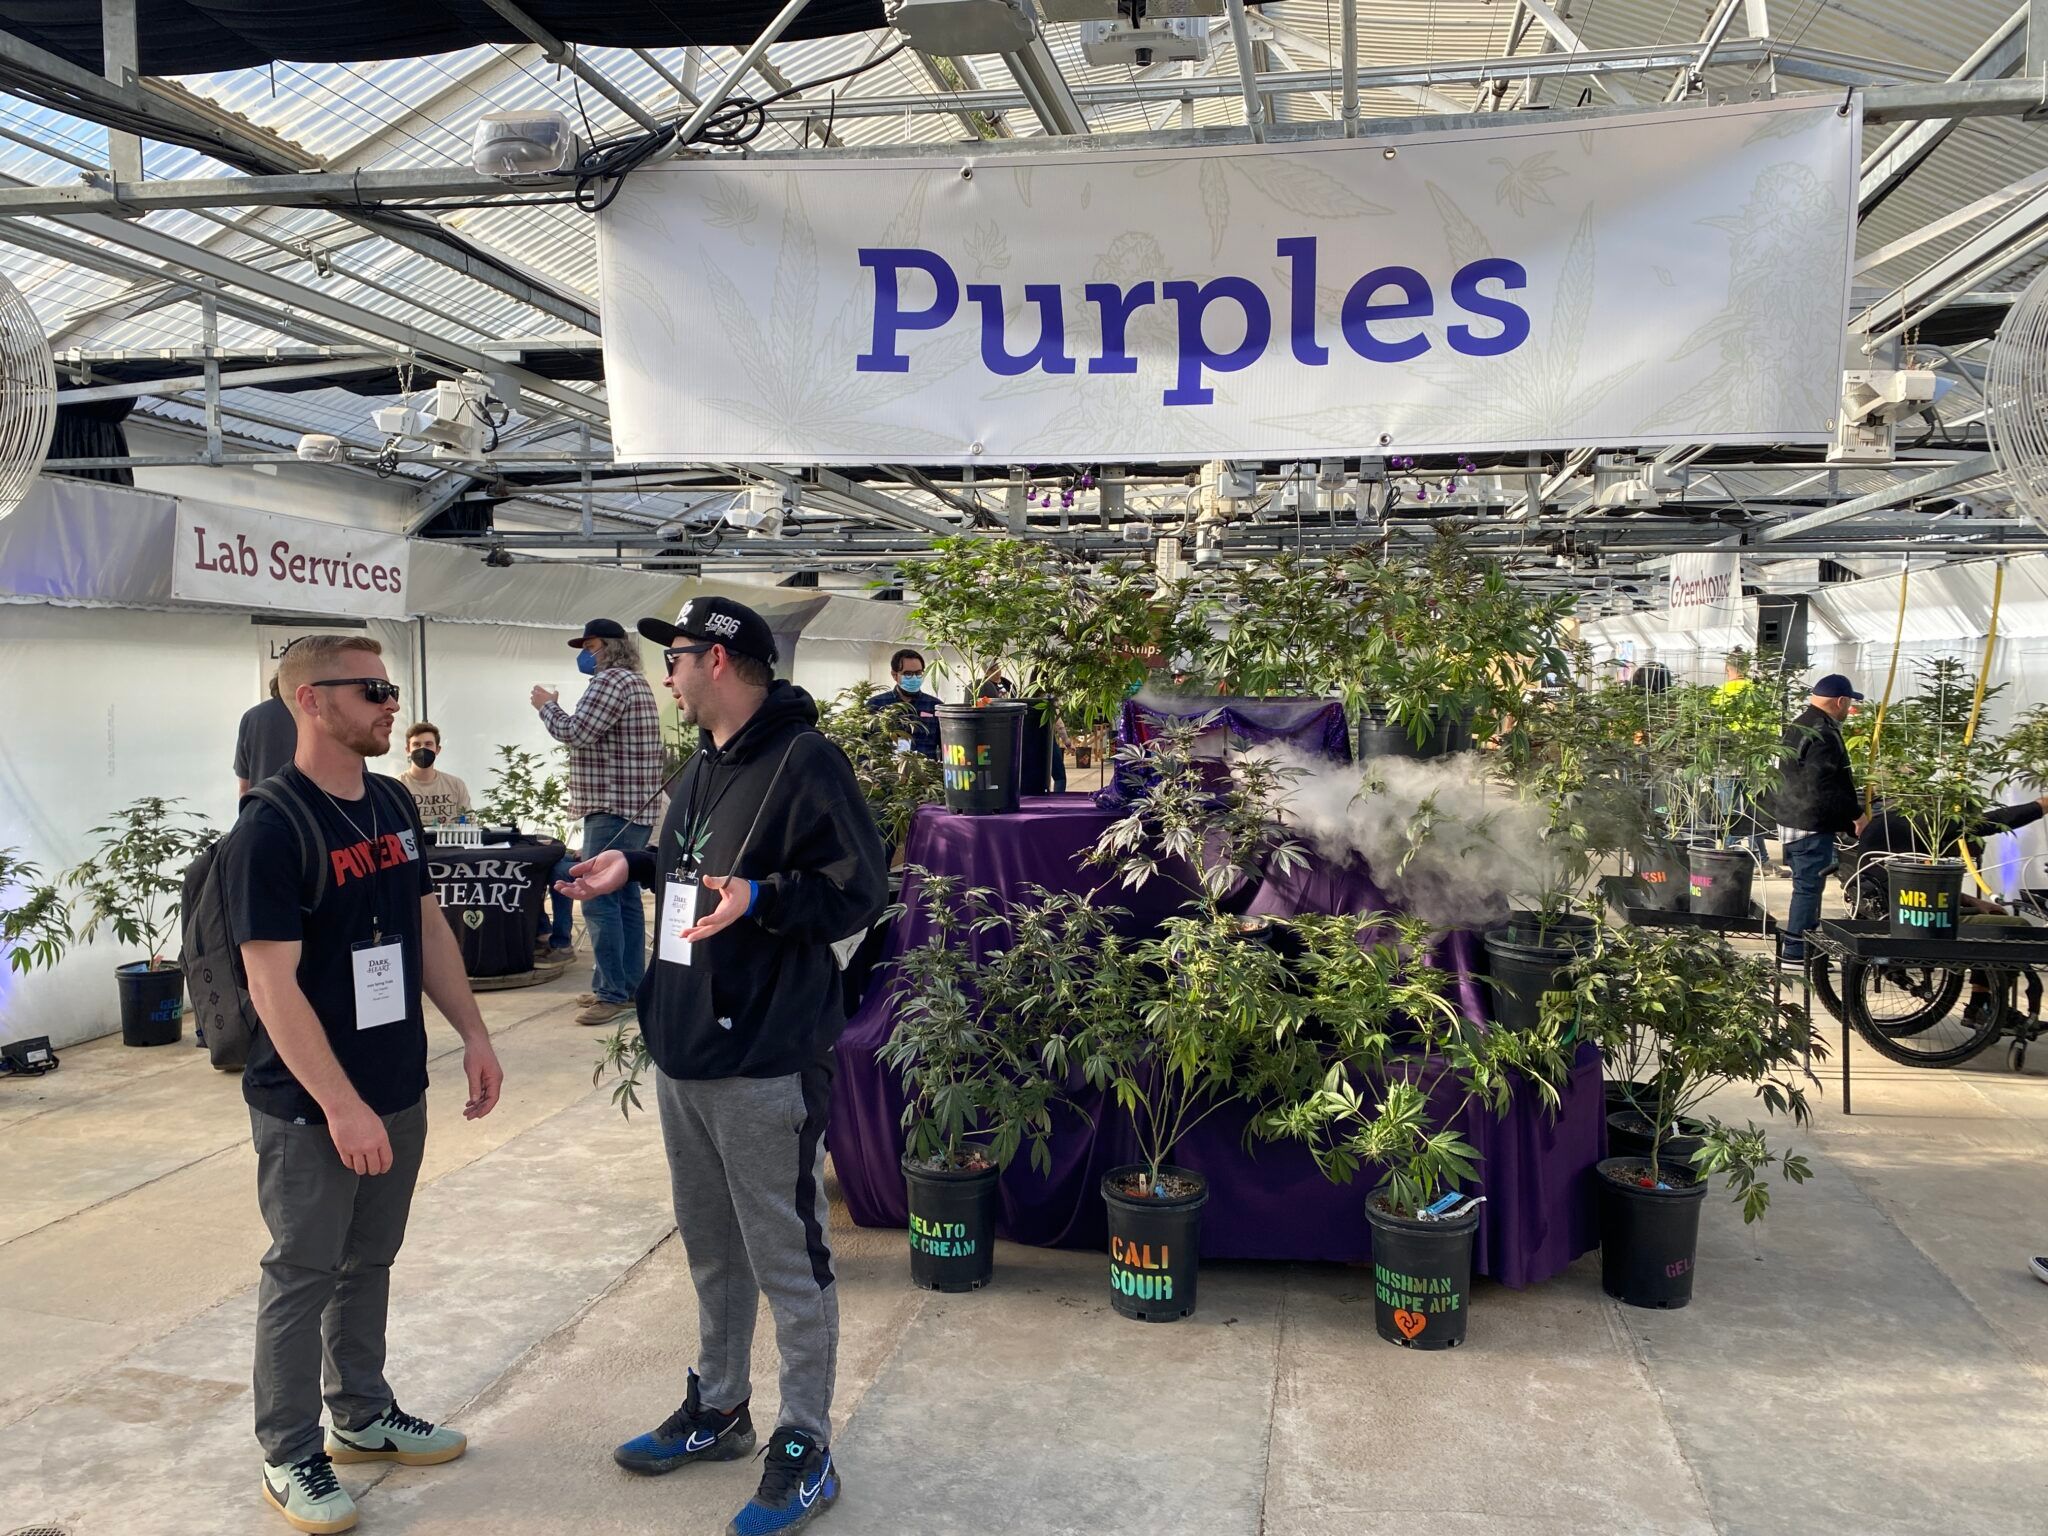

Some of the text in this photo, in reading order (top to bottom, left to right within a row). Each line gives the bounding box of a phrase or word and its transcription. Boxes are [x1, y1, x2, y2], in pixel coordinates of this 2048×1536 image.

[856, 237, 1531, 406] Purples
[194, 527, 401, 593] Lab Services
[704, 612, 741, 634] 1996
[943, 744, 992, 766] MR. E
[944, 769, 999, 791] PUPIL
[412, 793, 454, 806] DARK
[428, 859, 534, 881] DARK
[1899, 889, 1950, 908] MR. E
[1898, 908, 1952, 928] PUPIL
[368, 959, 391, 967] DARK
[910, 1212, 966, 1239] GELATO
[921, 1238, 976, 1257] CREAM
[1112, 1236, 1169, 1269] CALI
[1111, 1263, 1173, 1300] SOUR
[1375, 1263, 1451, 1295] KUSHMAN
[1376, 1282, 1460, 1313] GRAPE APE
